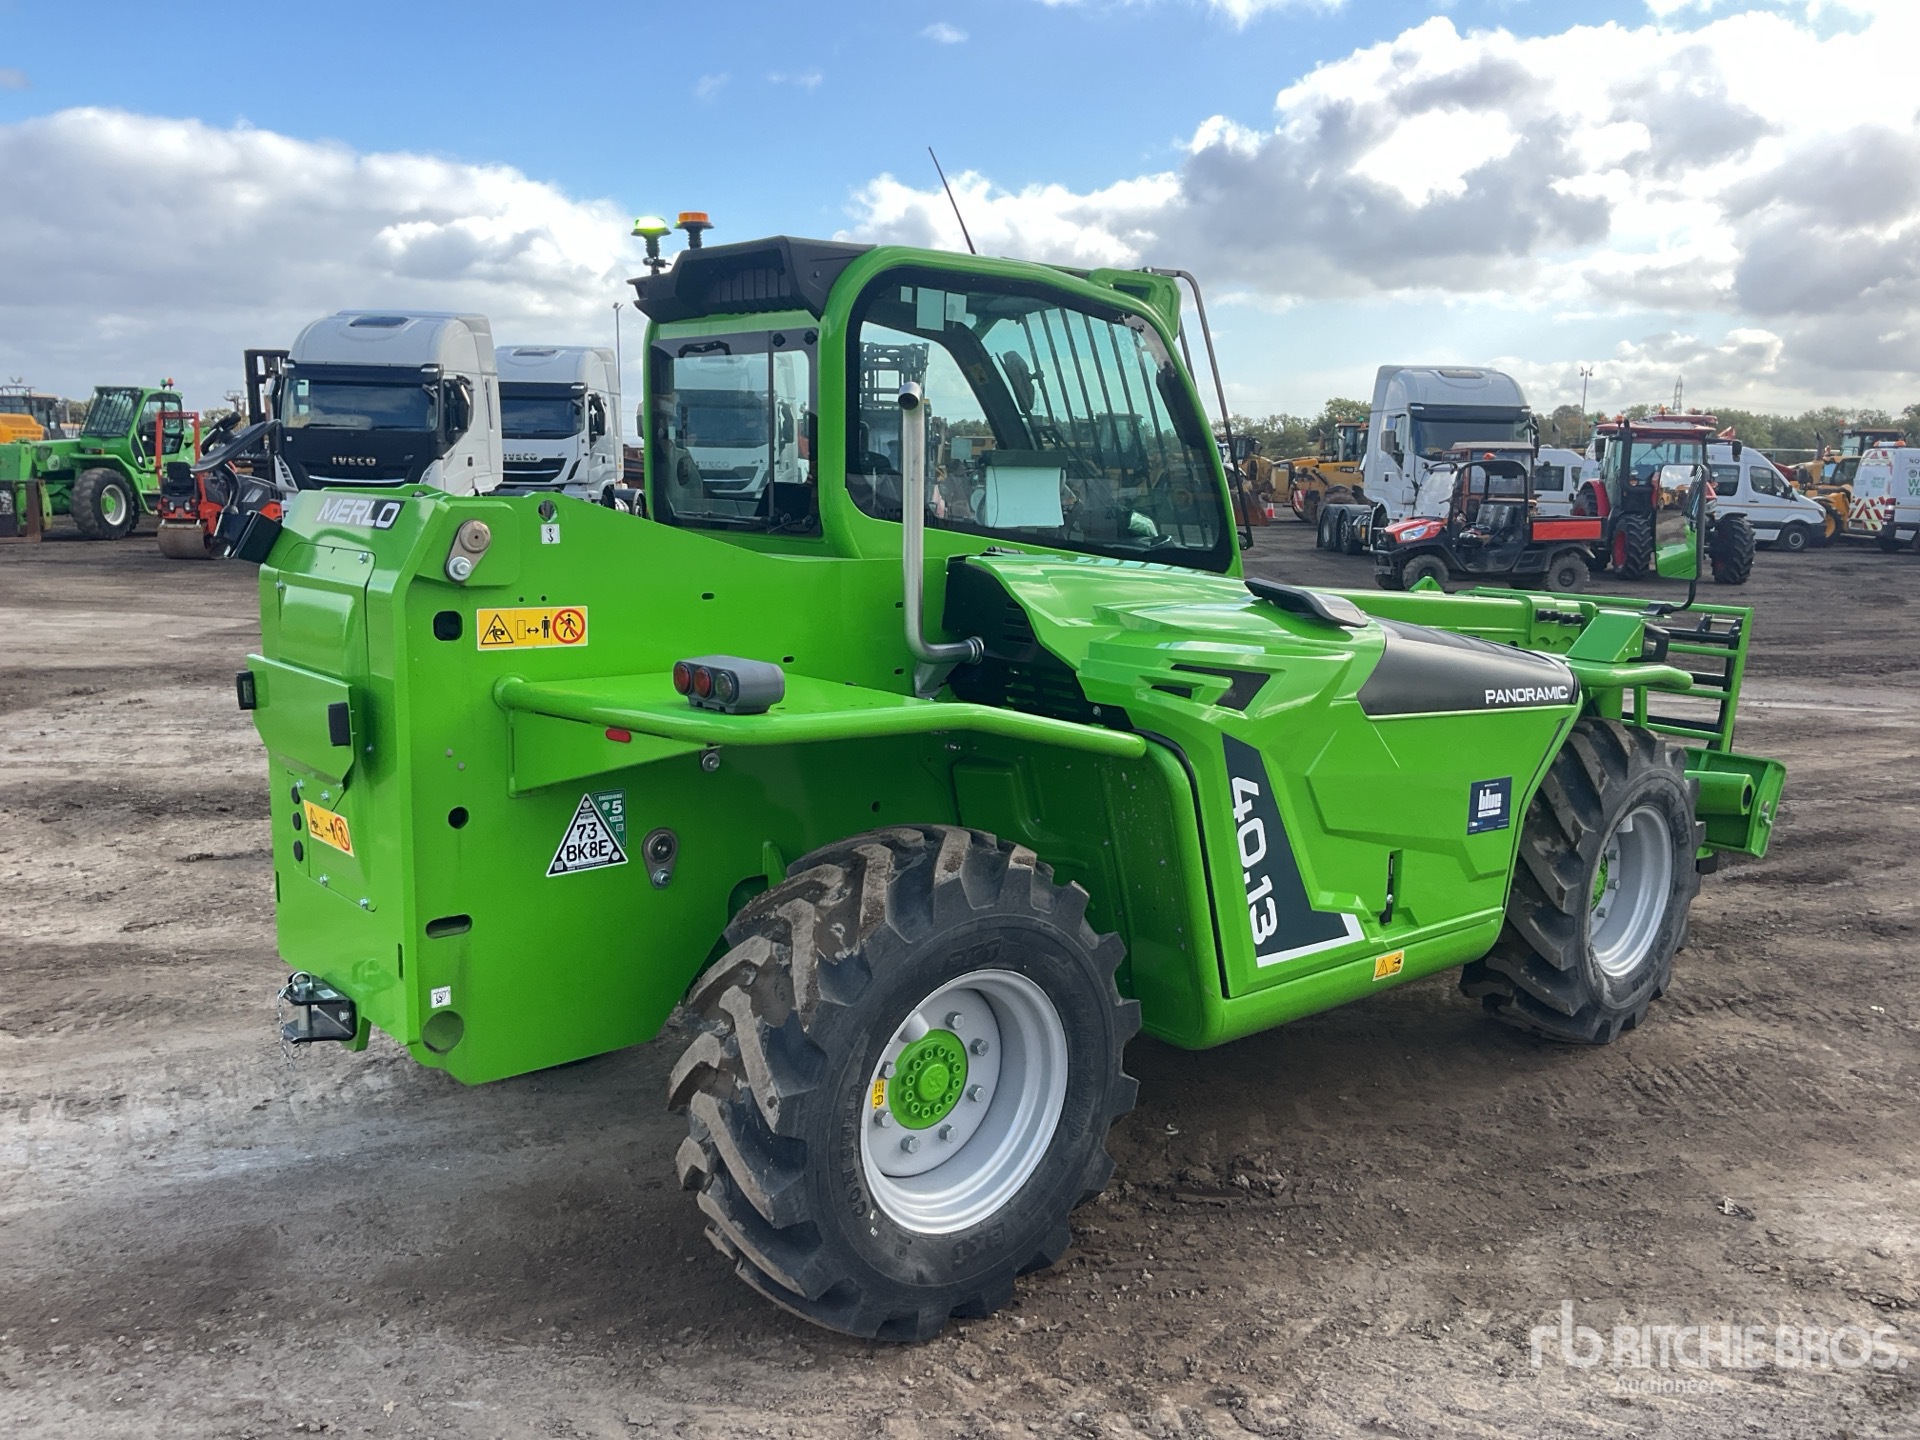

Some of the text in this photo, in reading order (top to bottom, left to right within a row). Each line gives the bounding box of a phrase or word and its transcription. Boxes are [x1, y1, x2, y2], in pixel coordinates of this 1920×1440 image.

[332, 456, 377, 467] IVECO
[503, 452, 538, 461] IVECO
[316, 497, 401, 529] MERLO
[1485, 686, 1569, 704] PANORAMIC
[611, 800, 623, 814] 5
[576, 822, 598, 842] 73
[566, 839, 609, 861] BK8E
[1231, 776, 1278, 945] 40.13
